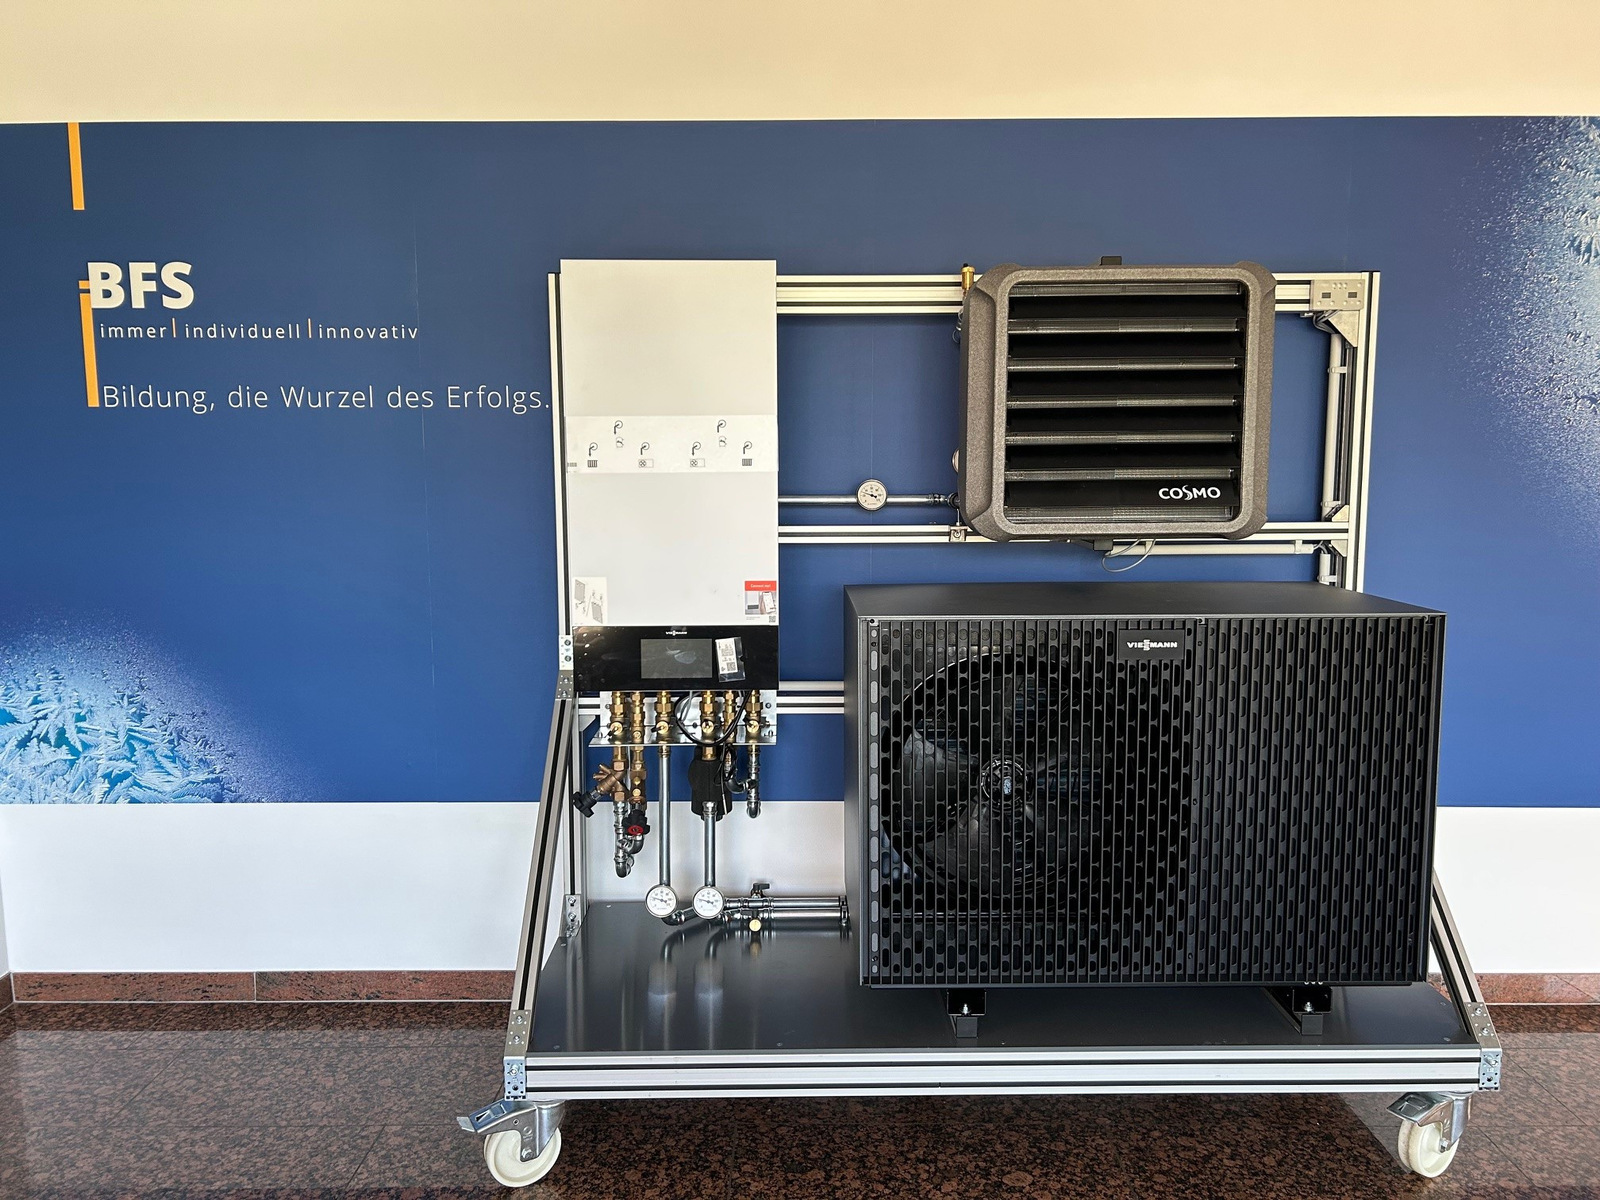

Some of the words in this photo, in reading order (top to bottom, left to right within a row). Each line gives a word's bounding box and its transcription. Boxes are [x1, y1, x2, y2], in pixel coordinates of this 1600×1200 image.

[87, 261, 195, 310] BFS
[100, 323, 167, 339] immer
[184, 323, 300, 339] individuell
[318, 324, 418, 339] innovativ
[103, 384, 215, 414] Bildung,
[228, 384, 268, 408] die
[280, 385, 373, 408] Wurzel
[387, 385, 434, 408] des
[447, 385, 550, 415] Erfolgs.
[1158, 485, 1221, 500] COSMO
